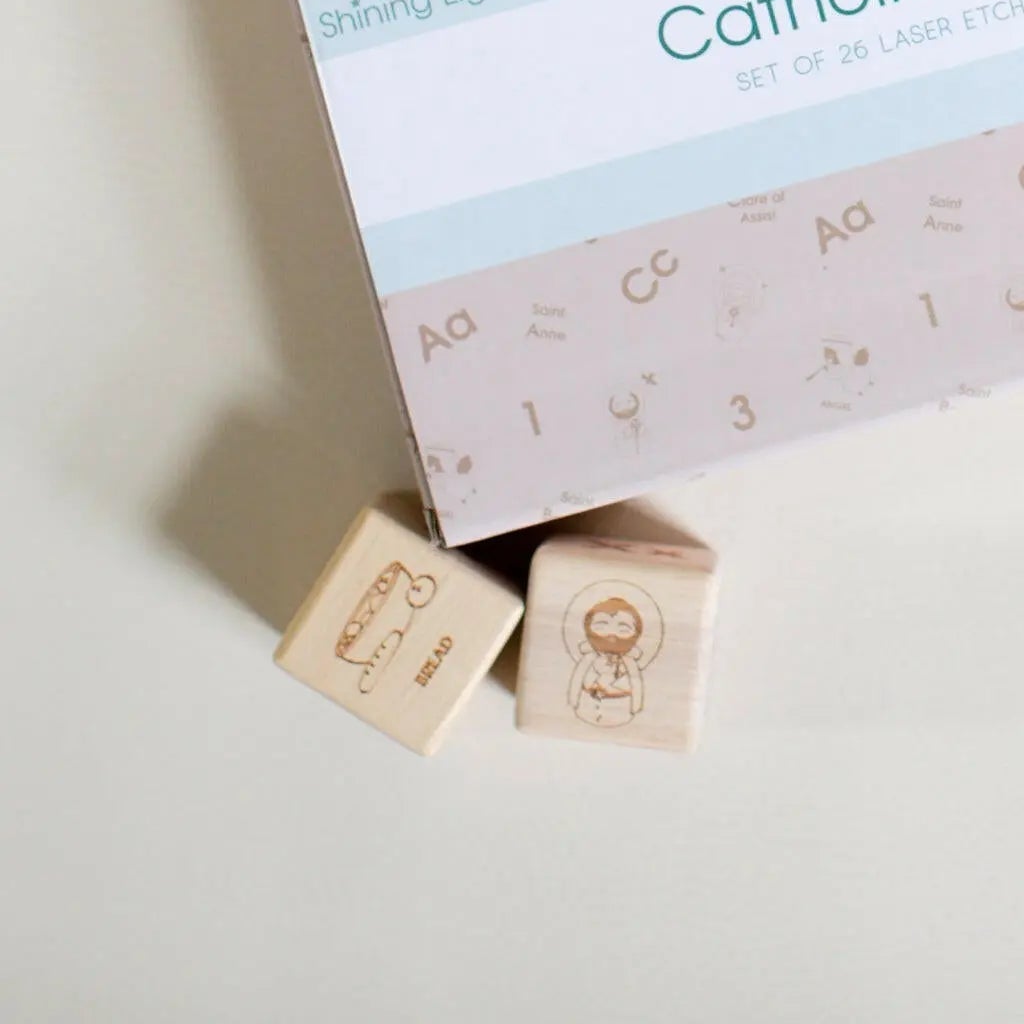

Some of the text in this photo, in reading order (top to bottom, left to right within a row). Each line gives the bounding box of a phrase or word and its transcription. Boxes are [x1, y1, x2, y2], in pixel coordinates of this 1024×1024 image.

[735, 63, 780, 92] SET
[793, 49, 825, 75] OF
[838, 39, 869, 64] 26
[878, 15, 953, 54] LASER
[929, 195, 962, 209] Saint
[815, 200, 875, 255] Aa
[923, 215, 963, 233] Anne
[621, 249, 678, 304] Cc
[532, 303, 566, 318] Saint
[918, 292, 939, 329] 1
[417, 308, 478, 363] Aa
[525, 323, 567, 342] Anne
[522, 400, 541, 436] 1
[730, 394, 756, 431] 3
[414, 636, 453, 687] BREAD
